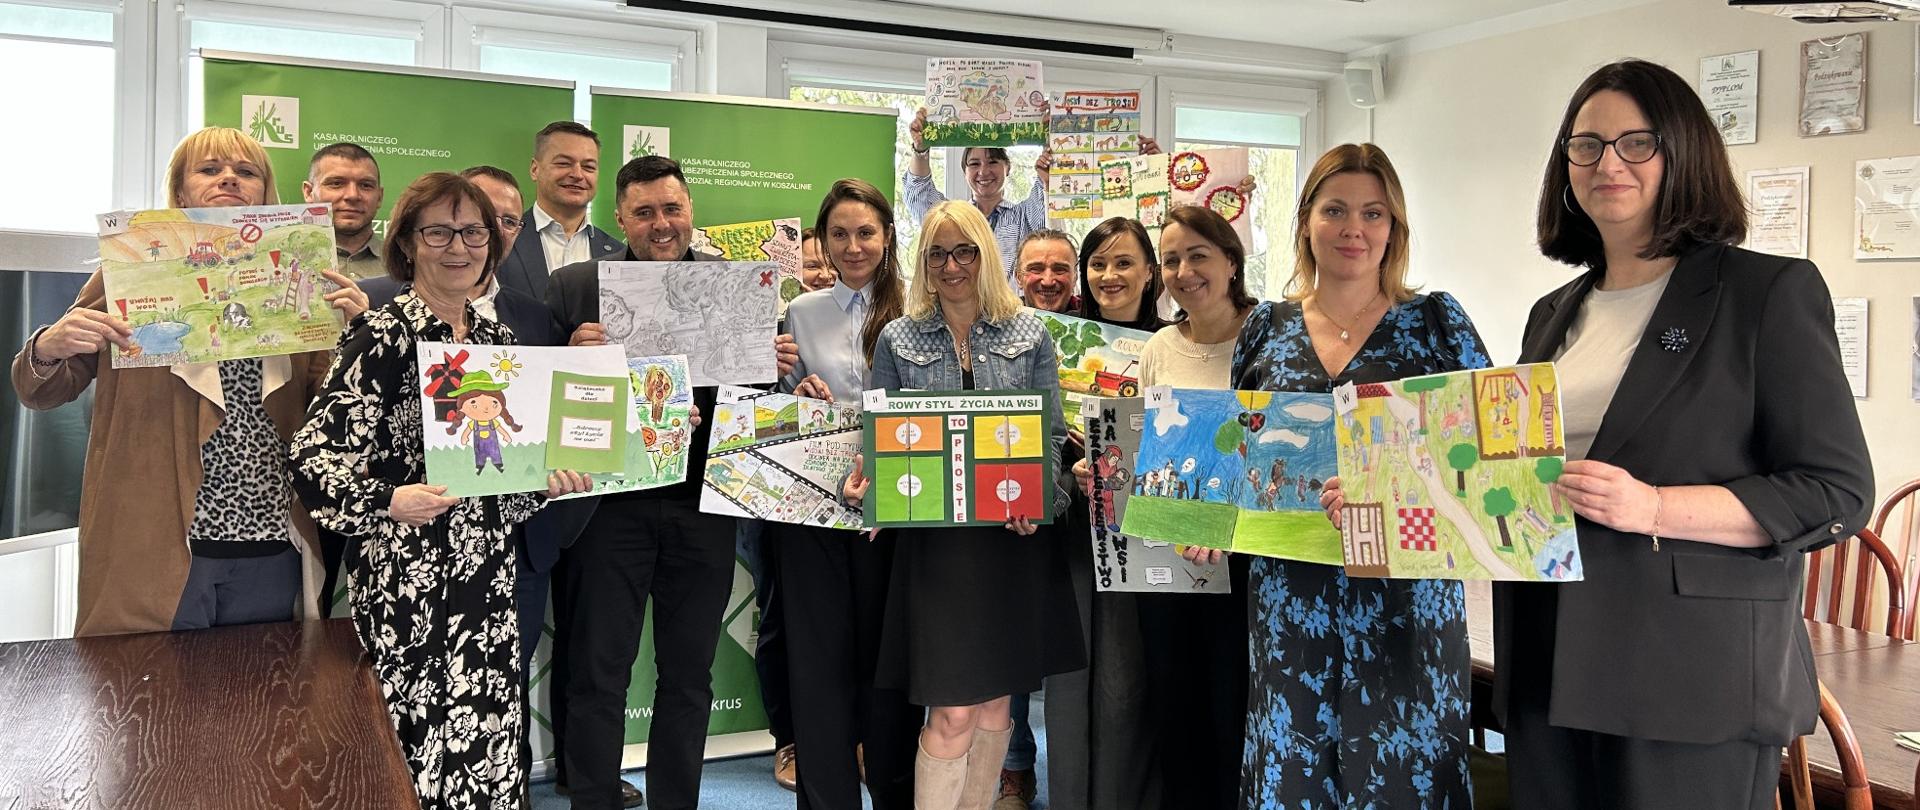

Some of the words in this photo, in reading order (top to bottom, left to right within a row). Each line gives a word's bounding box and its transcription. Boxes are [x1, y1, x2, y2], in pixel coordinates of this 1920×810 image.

[1711, 82, 1744, 94] DYPLOM
[313, 132, 338, 141] KASA
[340, 134, 398, 145] ROLNICZEGO
[386, 146, 451, 158] SPOŁECZNEGO
[702, 159, 751, 169] ROLNICZEGO
[681, 167, 740, 177] UBEZPIECZENIA
[740, 169, 794, 180] SPOŁECZNEGO
[714, 178, 763, 187] REGIONALNY
[771, 182, 813, 191] KOSZALINIE
[105, 218, 117, 228] W
[1153, 393, 1162, 401] W
[1341, 392, 1349, 404] W
[888, 400, 921, 409] ROWY
[925, 400, 954, 409] STYL
[960, 398, 994, 408] ŻYCIA
[997, 399, 1014, 408] NA
[1017, 399, 1038, 408] WSI
[951, 418, 966, 427] TO
[1104, 408, 1116, 441] NA
[954, 438, 964, 521] PROSTE
[1112, 534, 1128, 583] WSI
